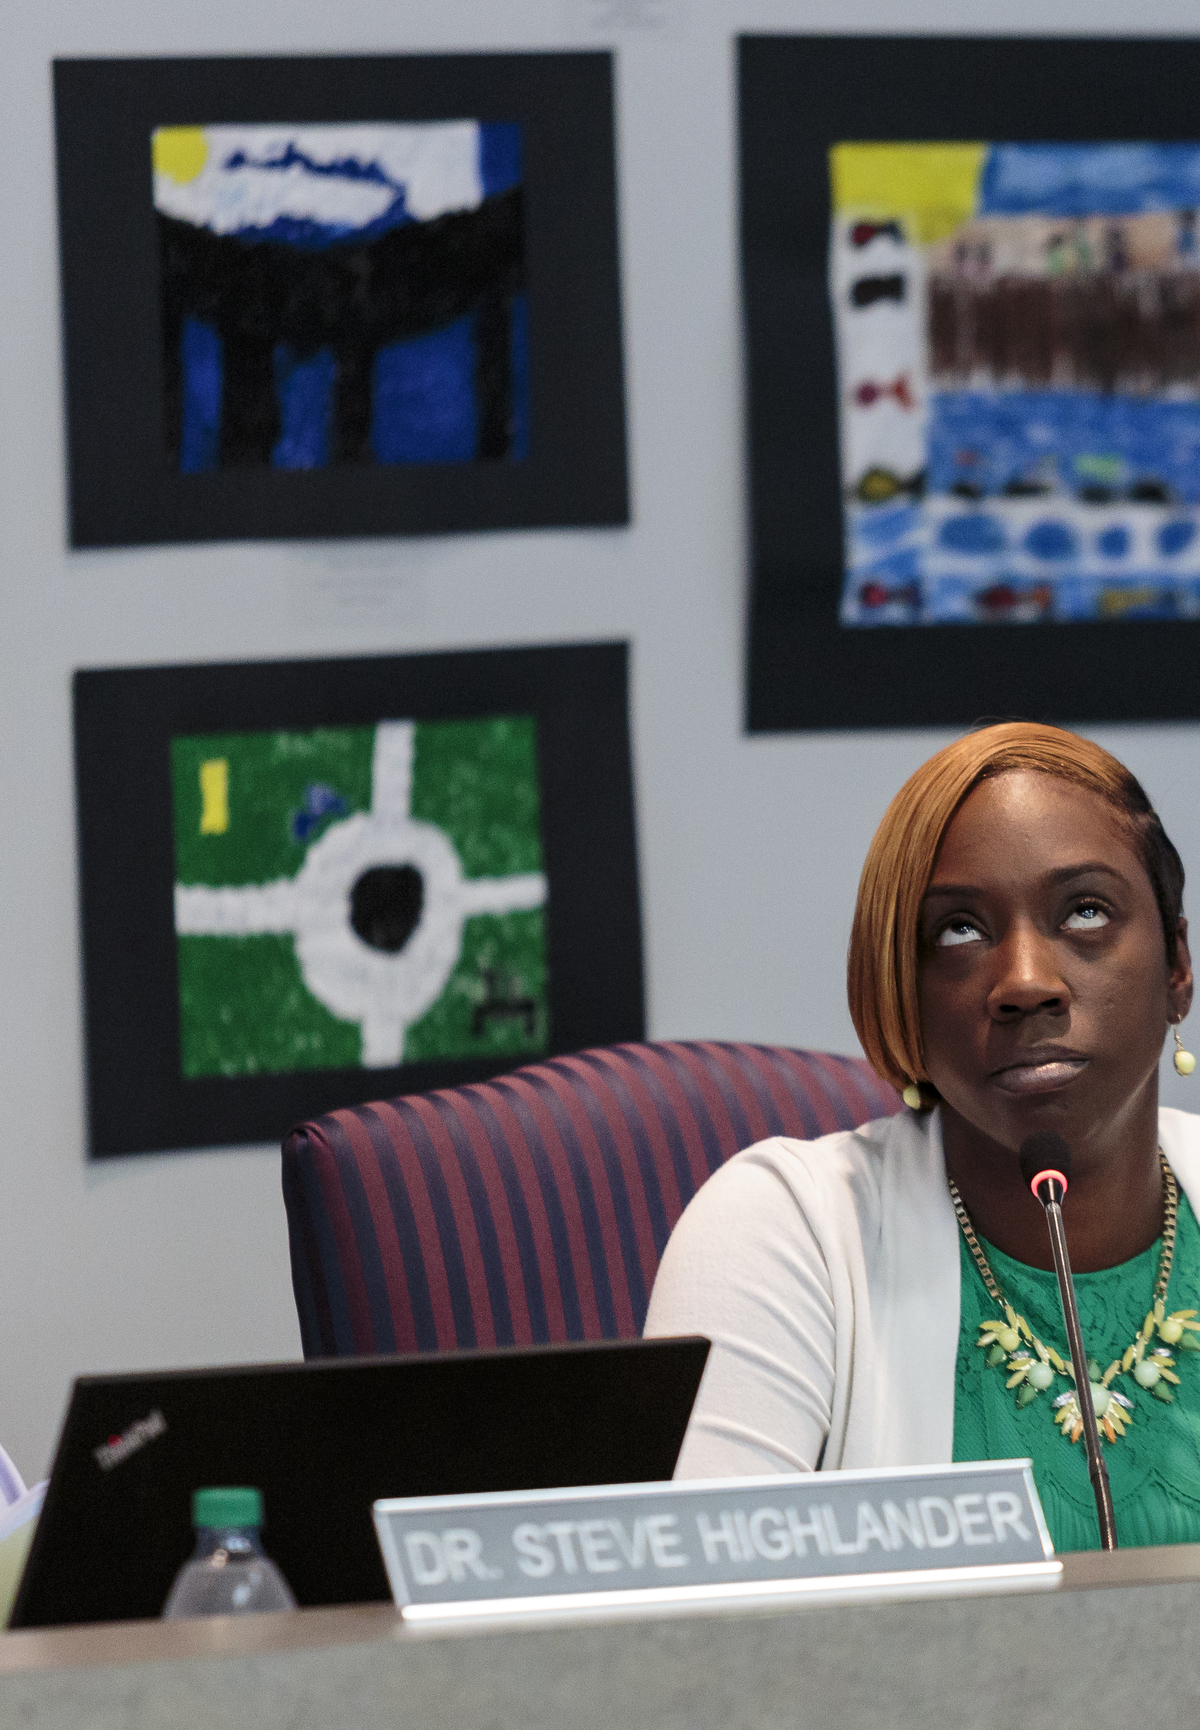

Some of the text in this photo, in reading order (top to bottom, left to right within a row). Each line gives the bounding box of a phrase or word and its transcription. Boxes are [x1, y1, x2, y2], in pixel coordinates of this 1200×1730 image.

[403, 1491, 1034, 1586] DR. STEVE HIGHLANDER
